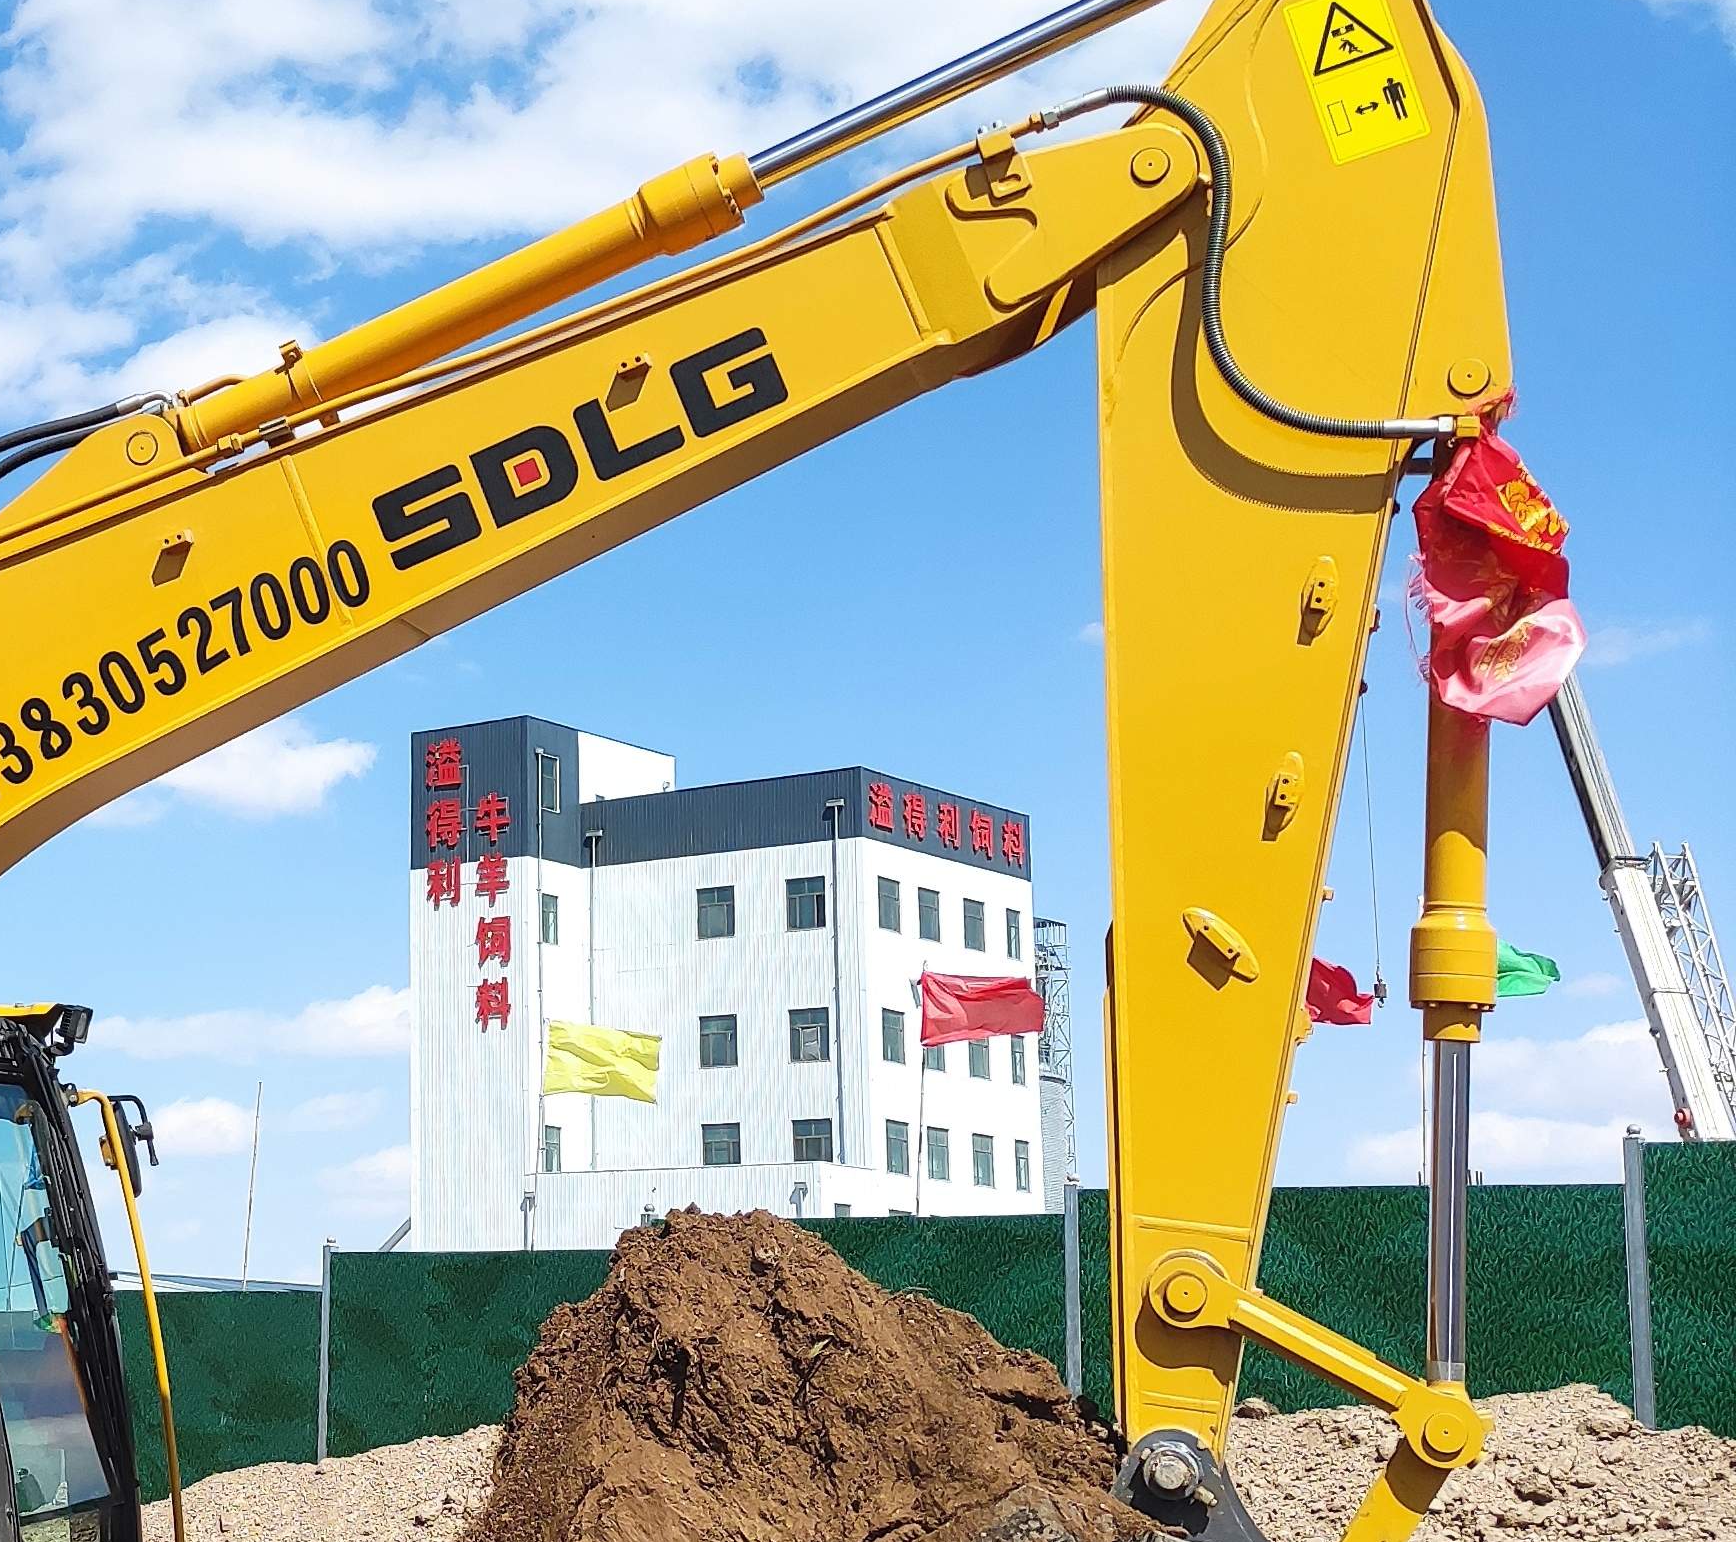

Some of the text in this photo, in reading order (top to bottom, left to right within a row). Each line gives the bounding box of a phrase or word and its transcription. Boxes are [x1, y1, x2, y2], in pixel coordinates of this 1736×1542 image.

[371, 326, 789, 571] SDLG
[425, 738, 462, 910] 溢得利
[475, 792, 511, 1032] 牛羊饲料
[868, 782, 1026, 869] 溢得利饲料
